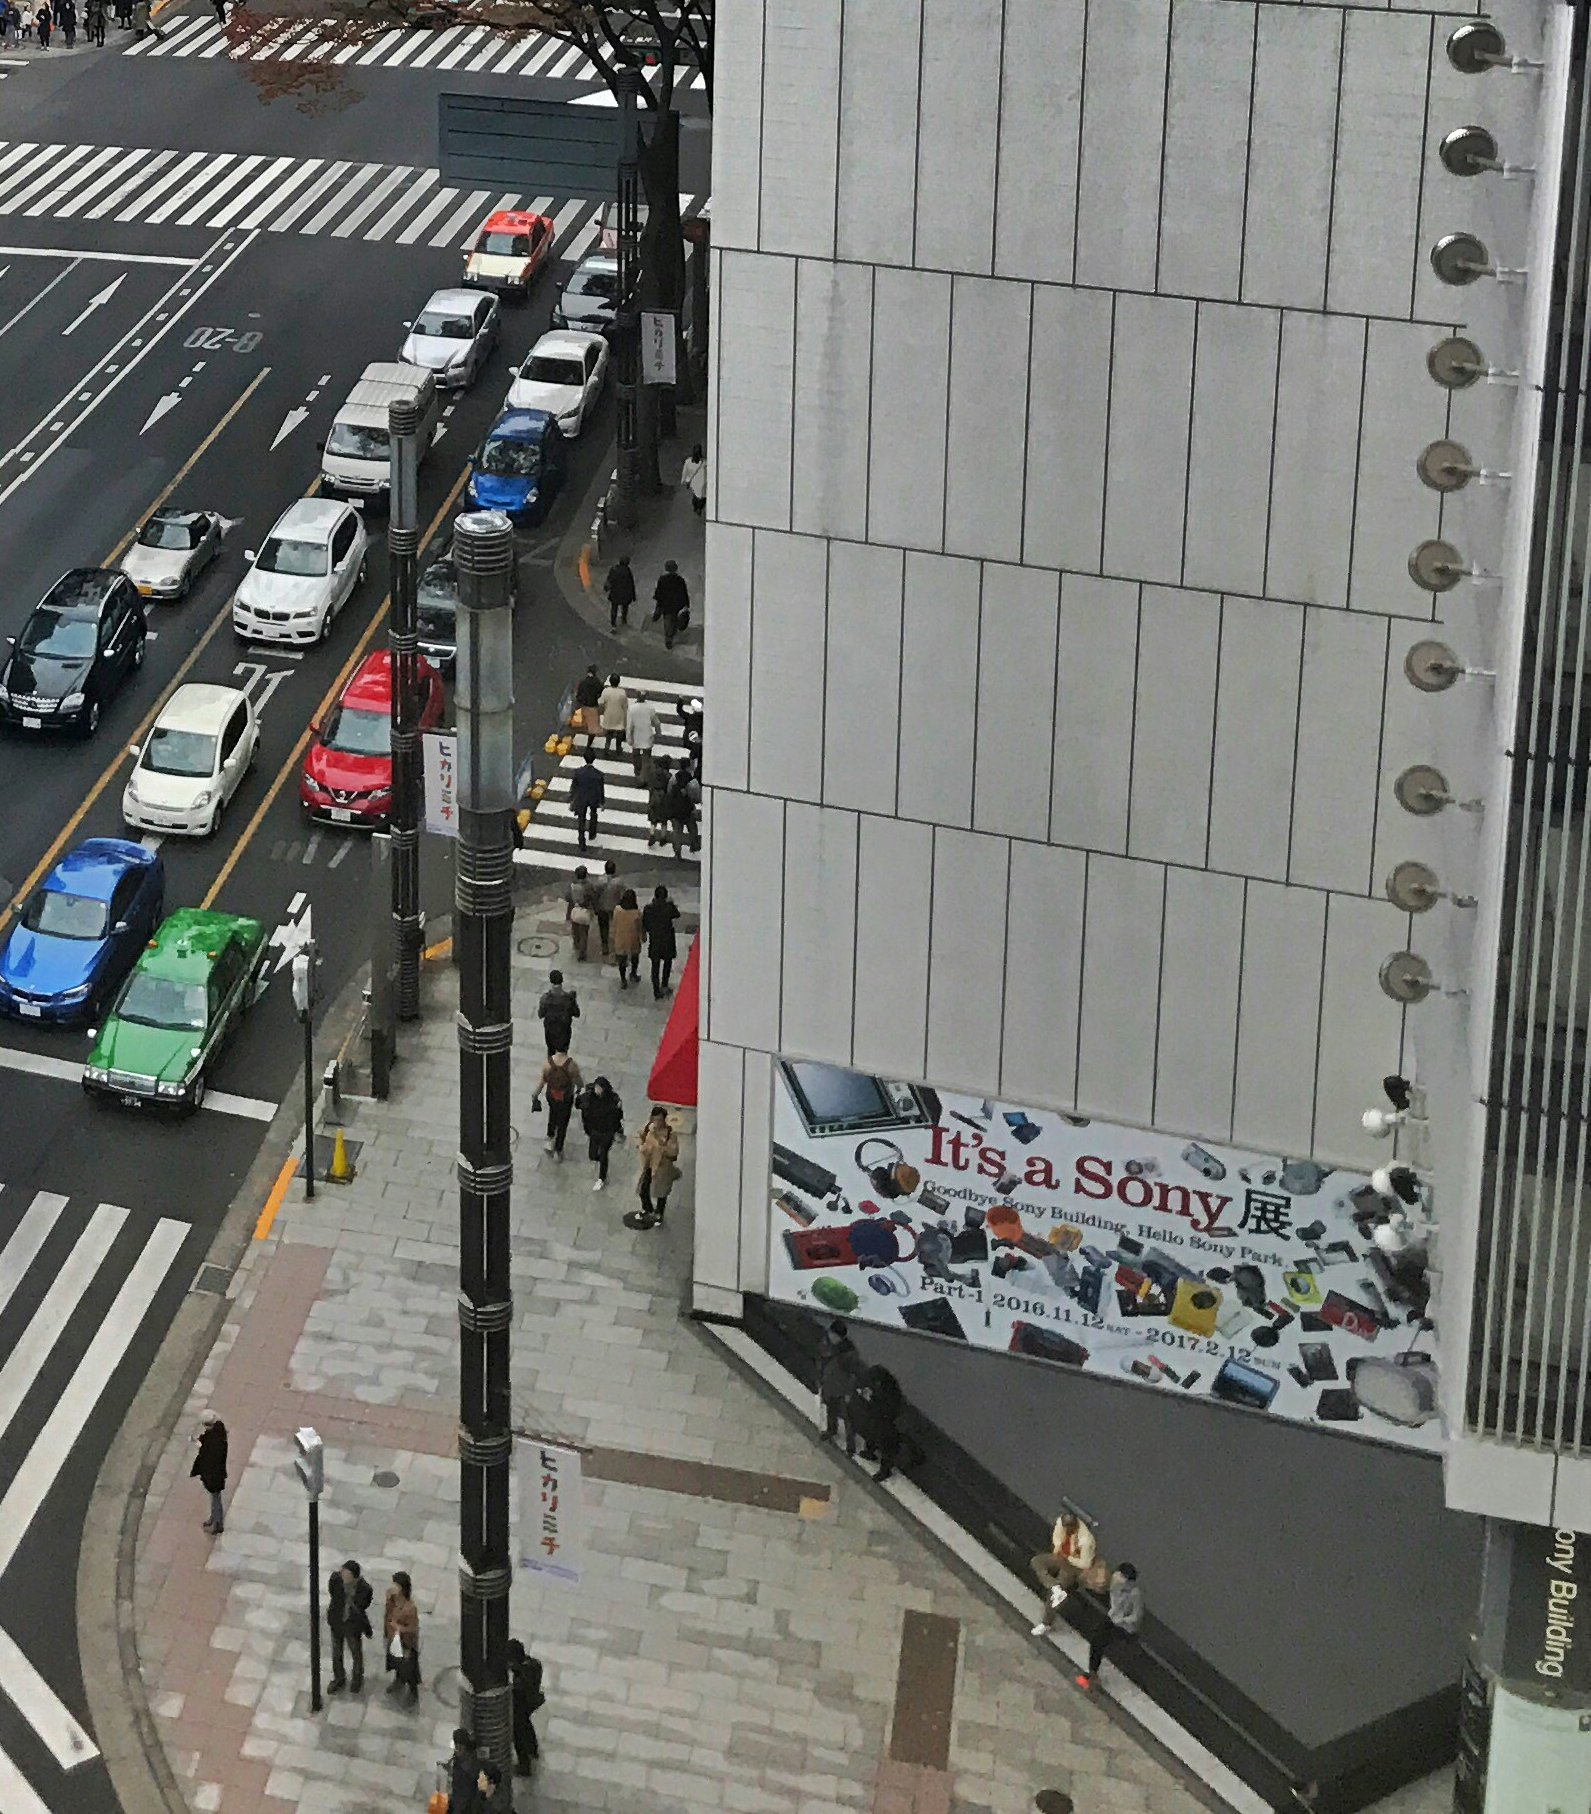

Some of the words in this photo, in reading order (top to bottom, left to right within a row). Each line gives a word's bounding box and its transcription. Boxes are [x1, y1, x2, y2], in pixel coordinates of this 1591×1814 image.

[437, 739, 454, 822] ヒカリミチ
[922, 1180, 1006, 1208] Goodbye
[1007, 1194, 1046, 1220] Sony
[1137, 1224, 1185, 1247] Hello
[1188, 1235, 1237, 1261] Sony
[924, 1123, 1007, 1179] It's
[1024, 1154, 1060, 1191] a
[1073, 1153, 1233, 1233] Sony
[1237, 1187, 1293, 1241] 展
[920, 1275, 984, 1304] Part-1
[992, 1293, 1106, 1330] 2016.11.12
[1145, 1328, 1253, 1363] 2017.2.12
[538, 1447, 562, 1556] ヒカリミチ
[1534, 1578, 1578, 1678] Building
